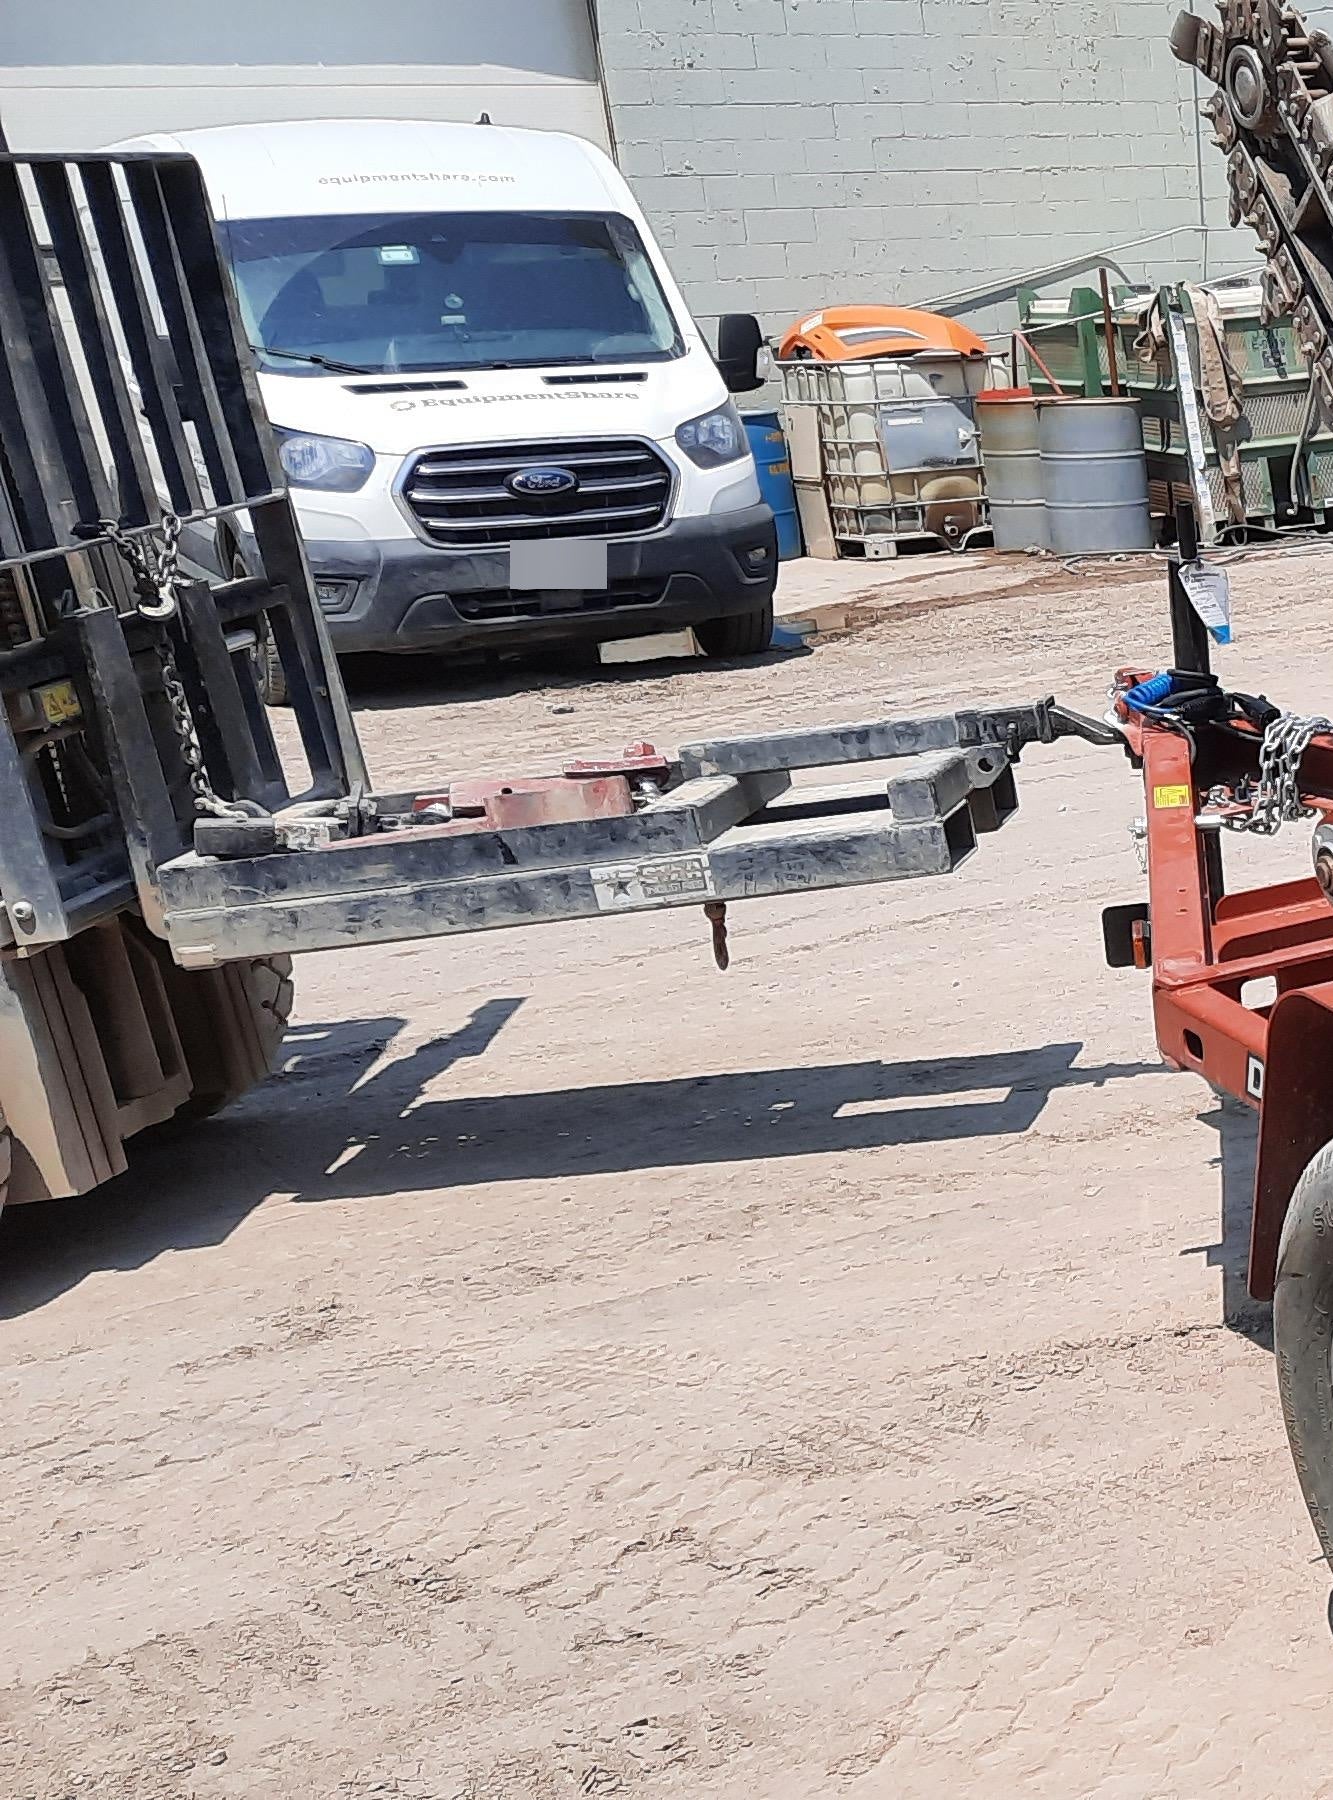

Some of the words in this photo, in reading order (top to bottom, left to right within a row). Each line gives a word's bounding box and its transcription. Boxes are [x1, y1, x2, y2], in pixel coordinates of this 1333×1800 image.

[318, 172, 516, 187] equipmentshare.com
[423, 390, 640, 408] EquipmentShare
[526, 474, 561, 489] Ford
